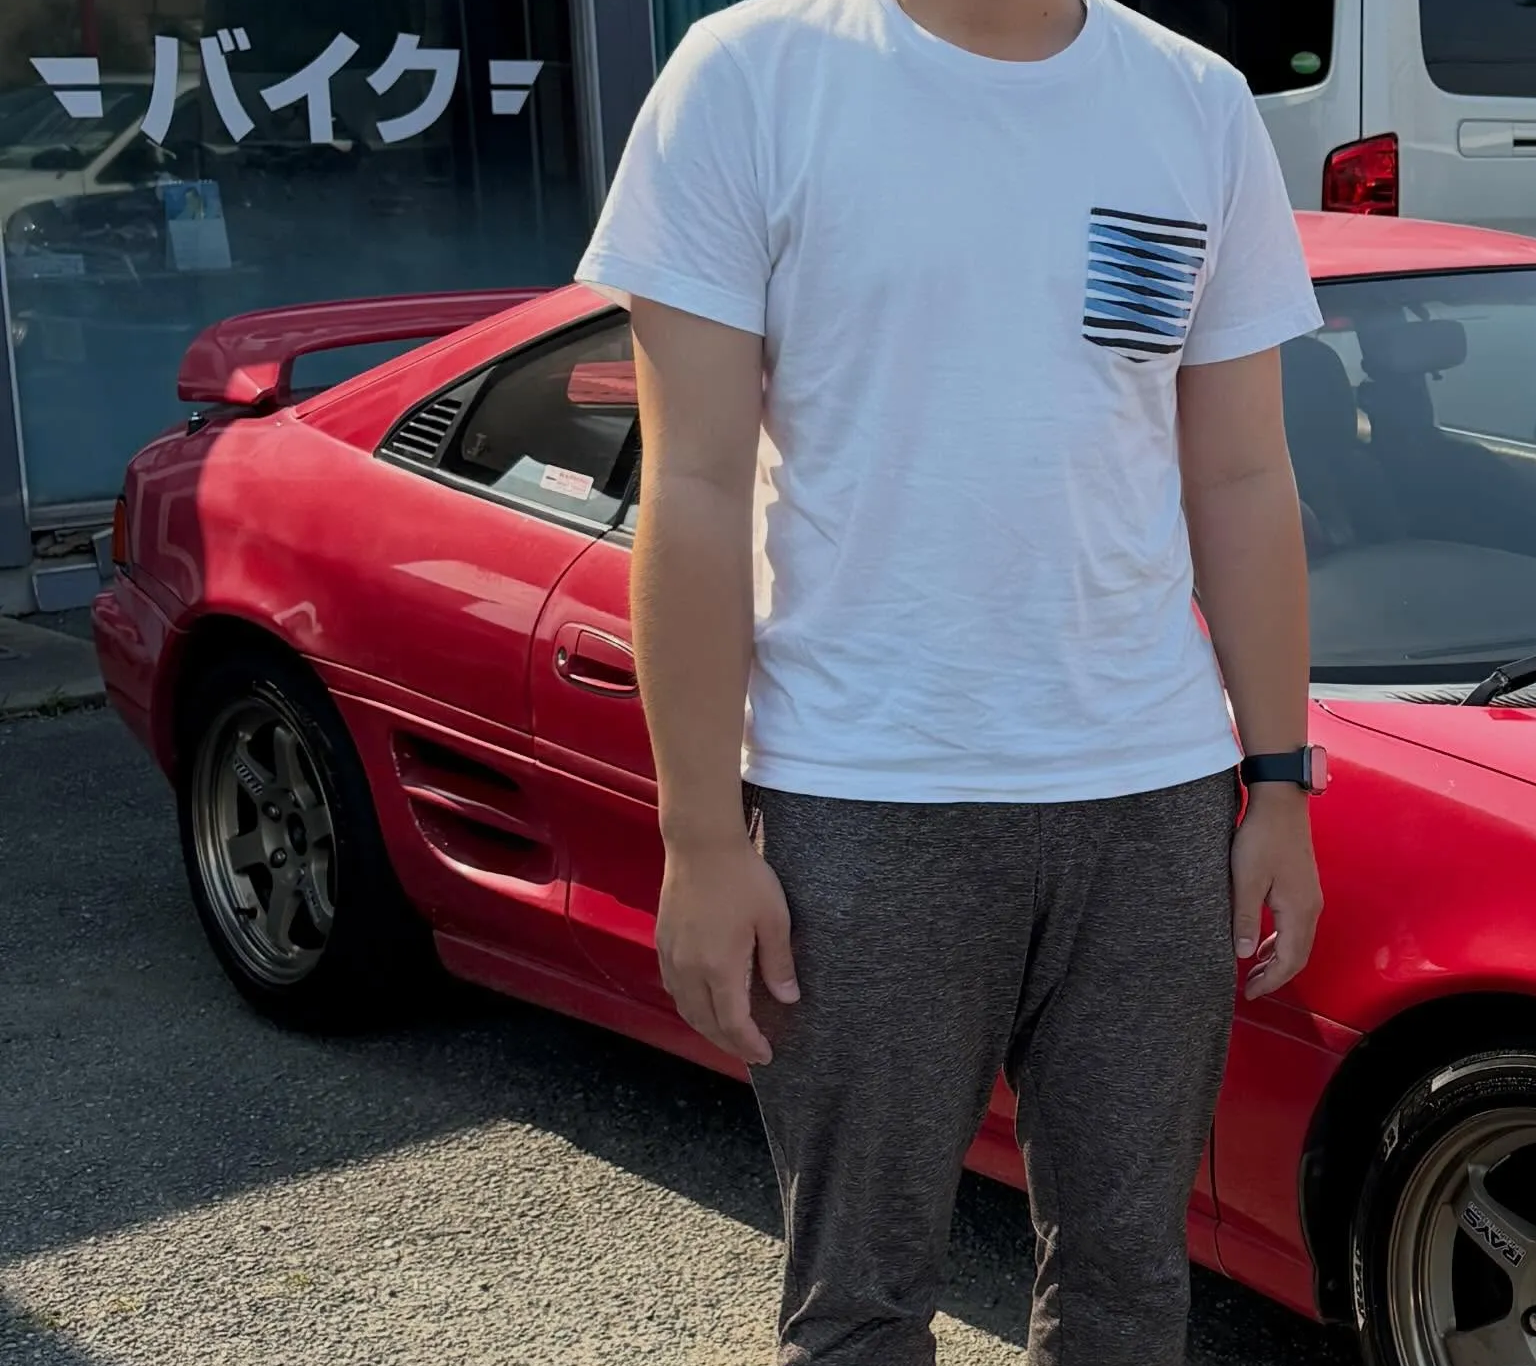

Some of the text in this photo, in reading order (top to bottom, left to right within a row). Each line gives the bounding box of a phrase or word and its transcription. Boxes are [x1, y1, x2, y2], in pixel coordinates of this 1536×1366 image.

[140, 26, 461, 144] バイク
[1461, 1206, 1523, 1268] RAYS
